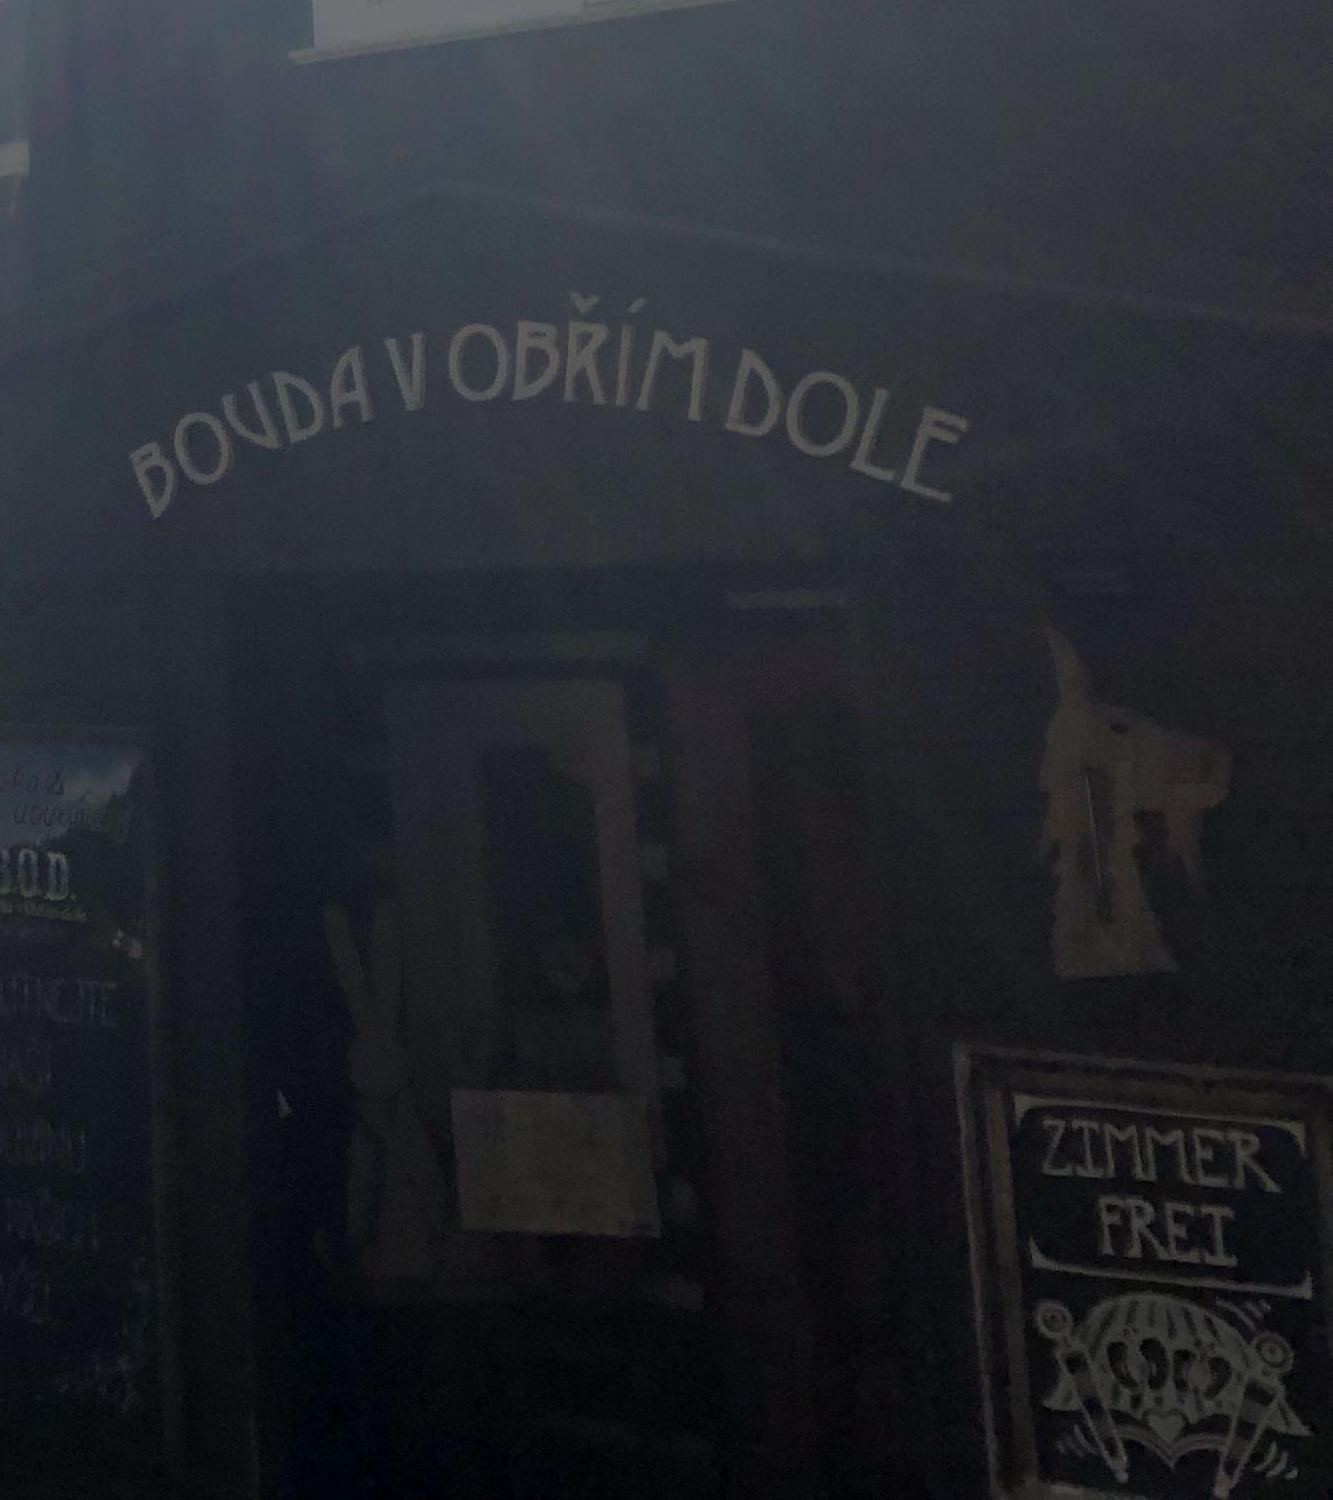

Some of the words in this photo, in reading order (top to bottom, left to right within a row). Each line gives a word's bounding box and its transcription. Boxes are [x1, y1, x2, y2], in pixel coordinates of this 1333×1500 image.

[130, 346, 375, 521] BOUDA
[383, 331, 426, 411] V
[448, 291, 710, 422] OBŘÍM
[724, 346, 971, 503] DOLE
[1041, 1116, 1285, 1194] ZIMMER
[1097, 1193, 1238, 1268] FREI
